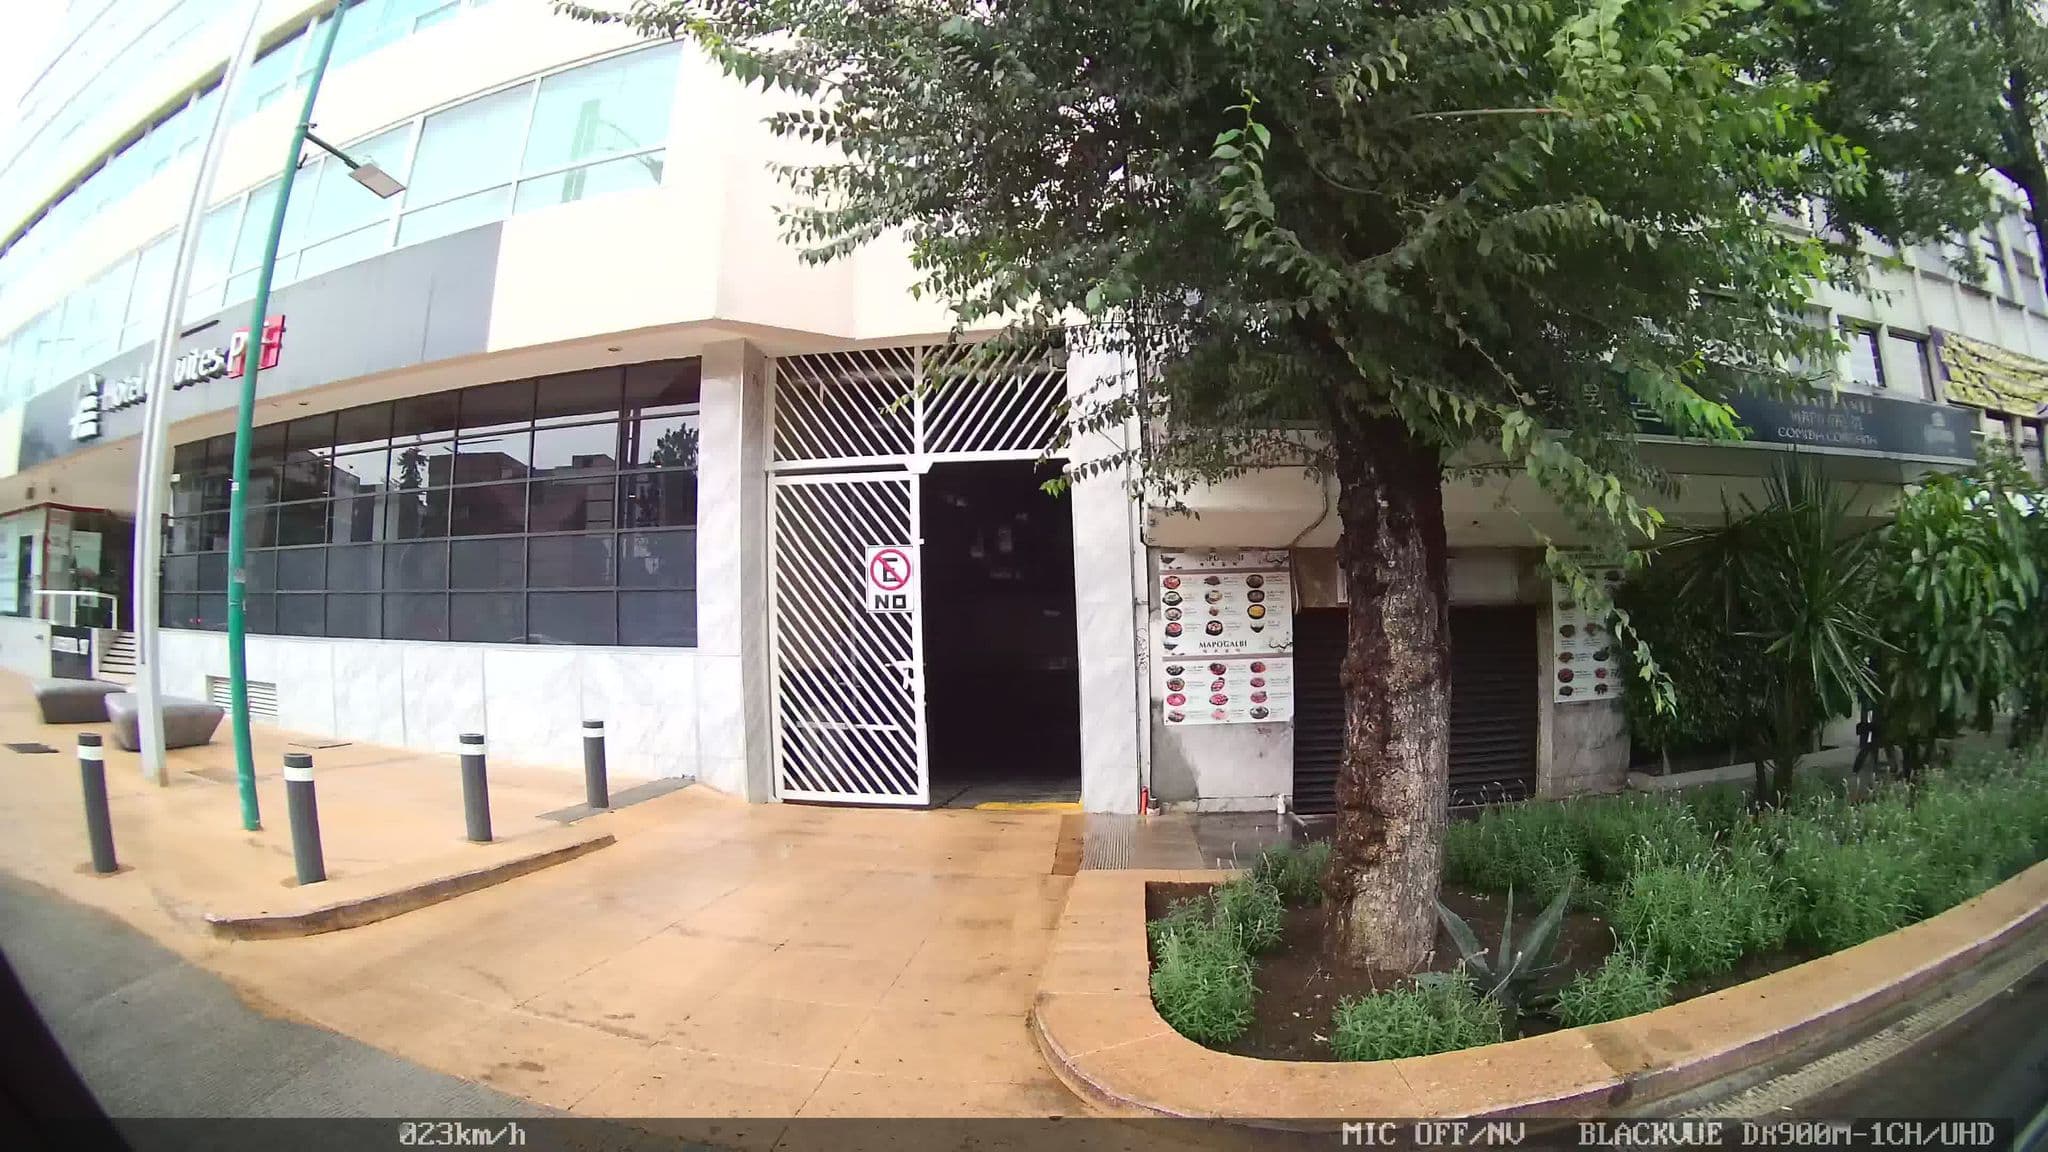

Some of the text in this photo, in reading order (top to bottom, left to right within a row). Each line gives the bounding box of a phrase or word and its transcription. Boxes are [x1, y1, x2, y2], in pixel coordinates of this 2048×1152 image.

[170, 346, 227, 388] uites
[874, 594, 906, 609] NO
[1199, 640, 1248, 649] MAPOGALBI
